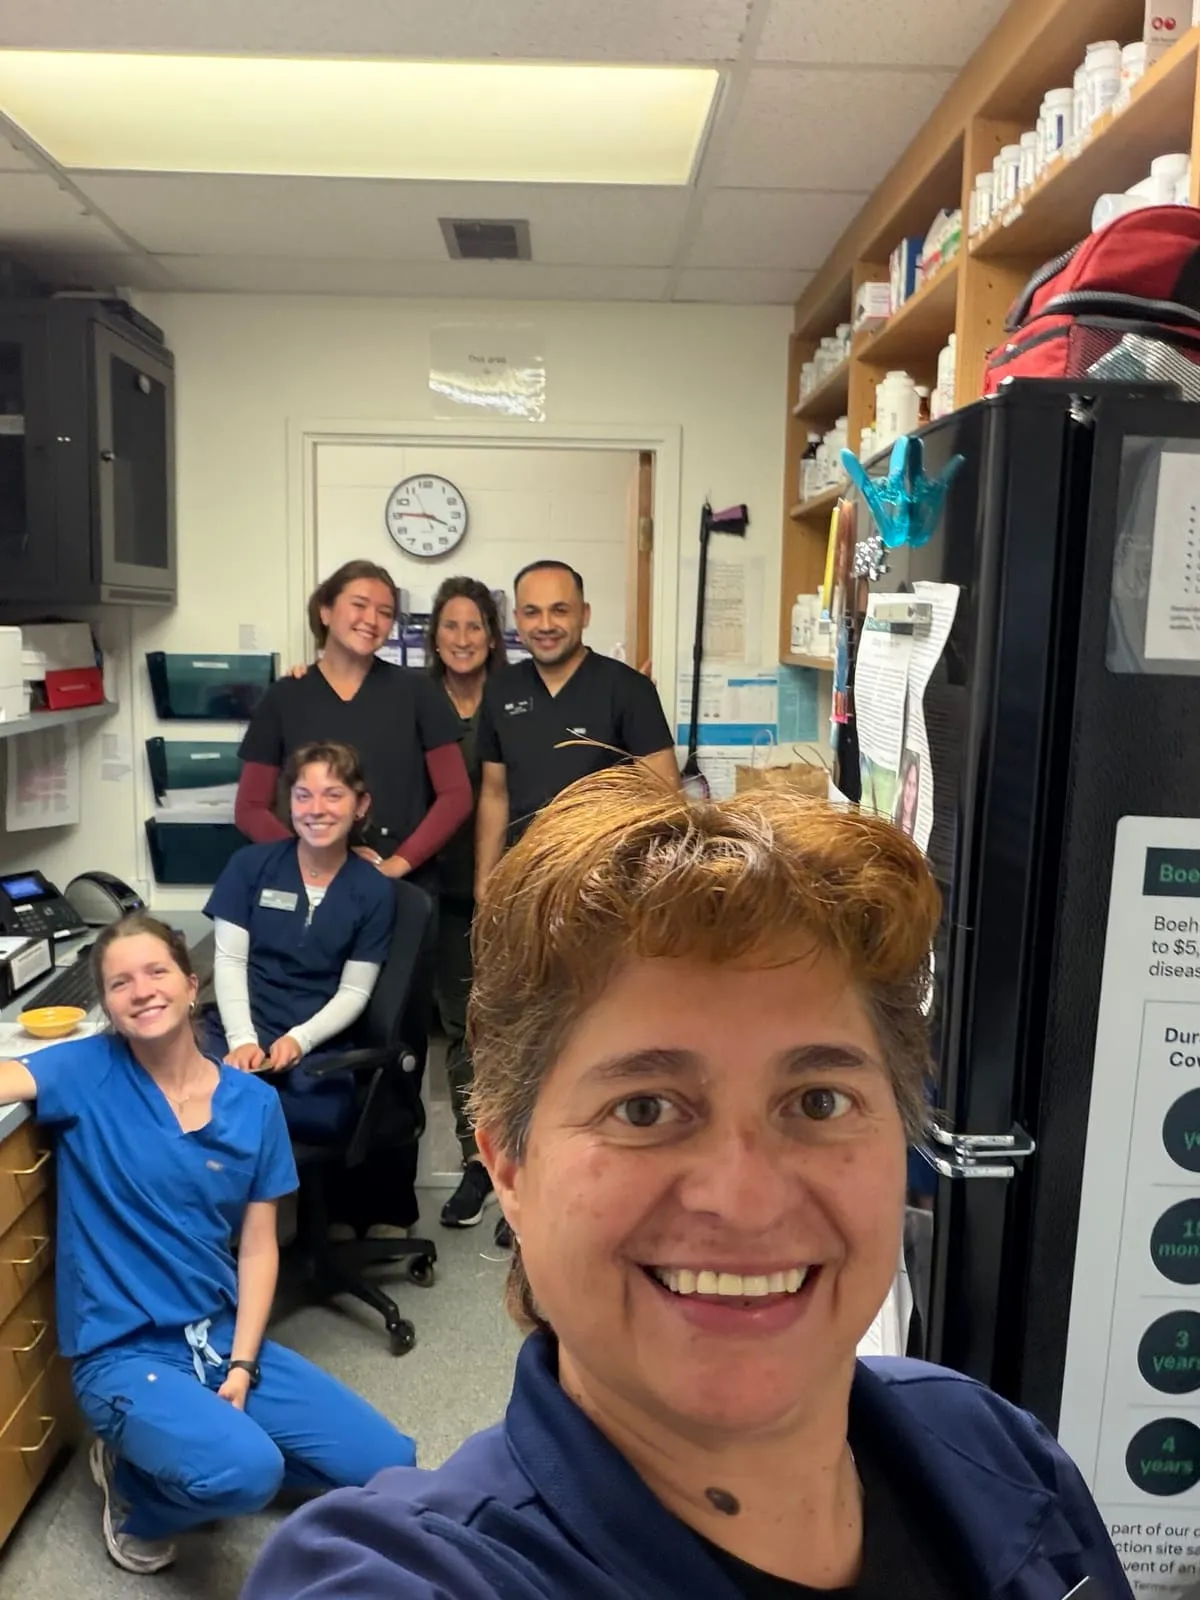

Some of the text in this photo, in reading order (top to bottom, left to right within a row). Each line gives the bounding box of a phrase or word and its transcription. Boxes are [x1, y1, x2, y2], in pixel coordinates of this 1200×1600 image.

[1159, 863, 1200, 883] Boe
[1154, 915, 1200, 933] Boeh
[1152, 938, 1200, 959] to $5,
[1149, 960, 1200, 978] diseas
[1165, 1027, 1200, 1045] Dur
[1158, 1243, 1200, 1257] mon
[1175, 1329, 1190, 1349] 3
[1161, 1435, 1175, 1453] 4
[1140, 1459, 1194, 1477] years
[1111, 1523, 1142, 1537] part
[1145, 1522, 1162, 1537] of
[1164, 1526, 1191, 1537] our
[1156, 1541, 1183, 1555] site
[1159, 1560, 1176, 1574] of
[1178, 1564, 1196, 1575] an
